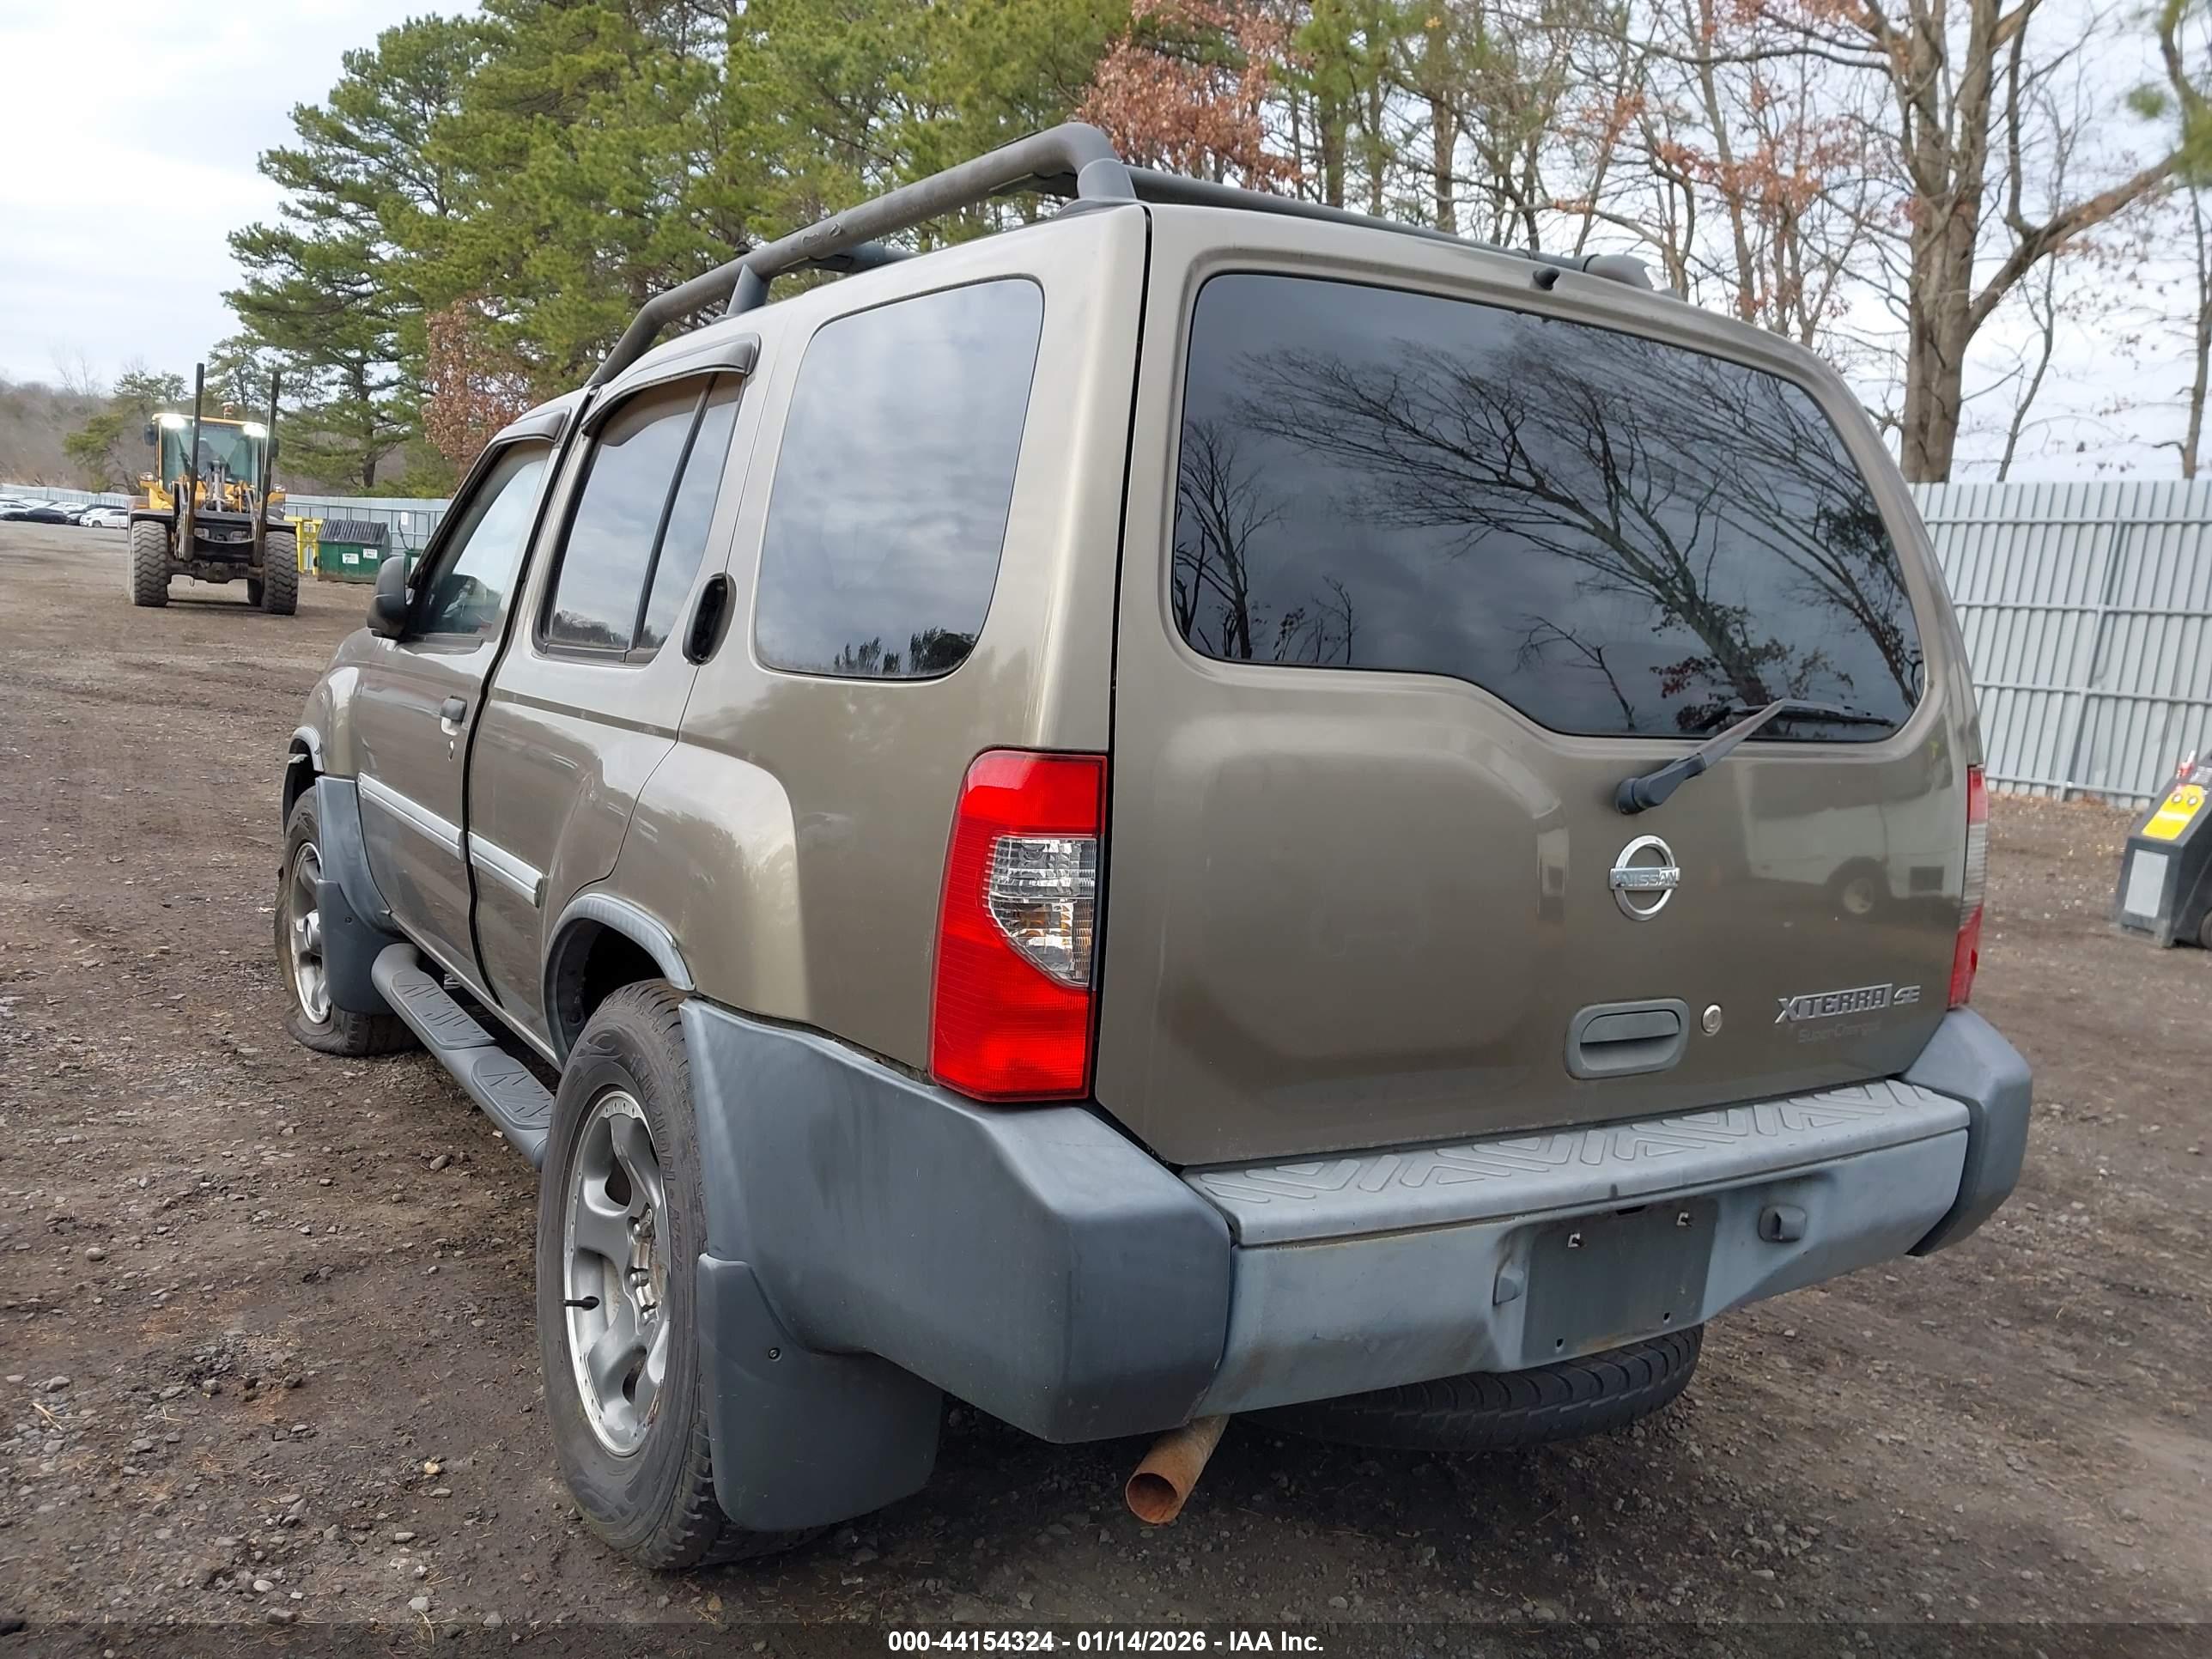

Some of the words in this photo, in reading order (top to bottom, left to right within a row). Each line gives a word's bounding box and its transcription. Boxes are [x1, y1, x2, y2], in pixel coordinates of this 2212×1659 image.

[1620, 870, 1678, 887] NISSAN
[1774, 983, 1893, 1024] XTERRA
[1893, 985, 1921, 1005] SE
